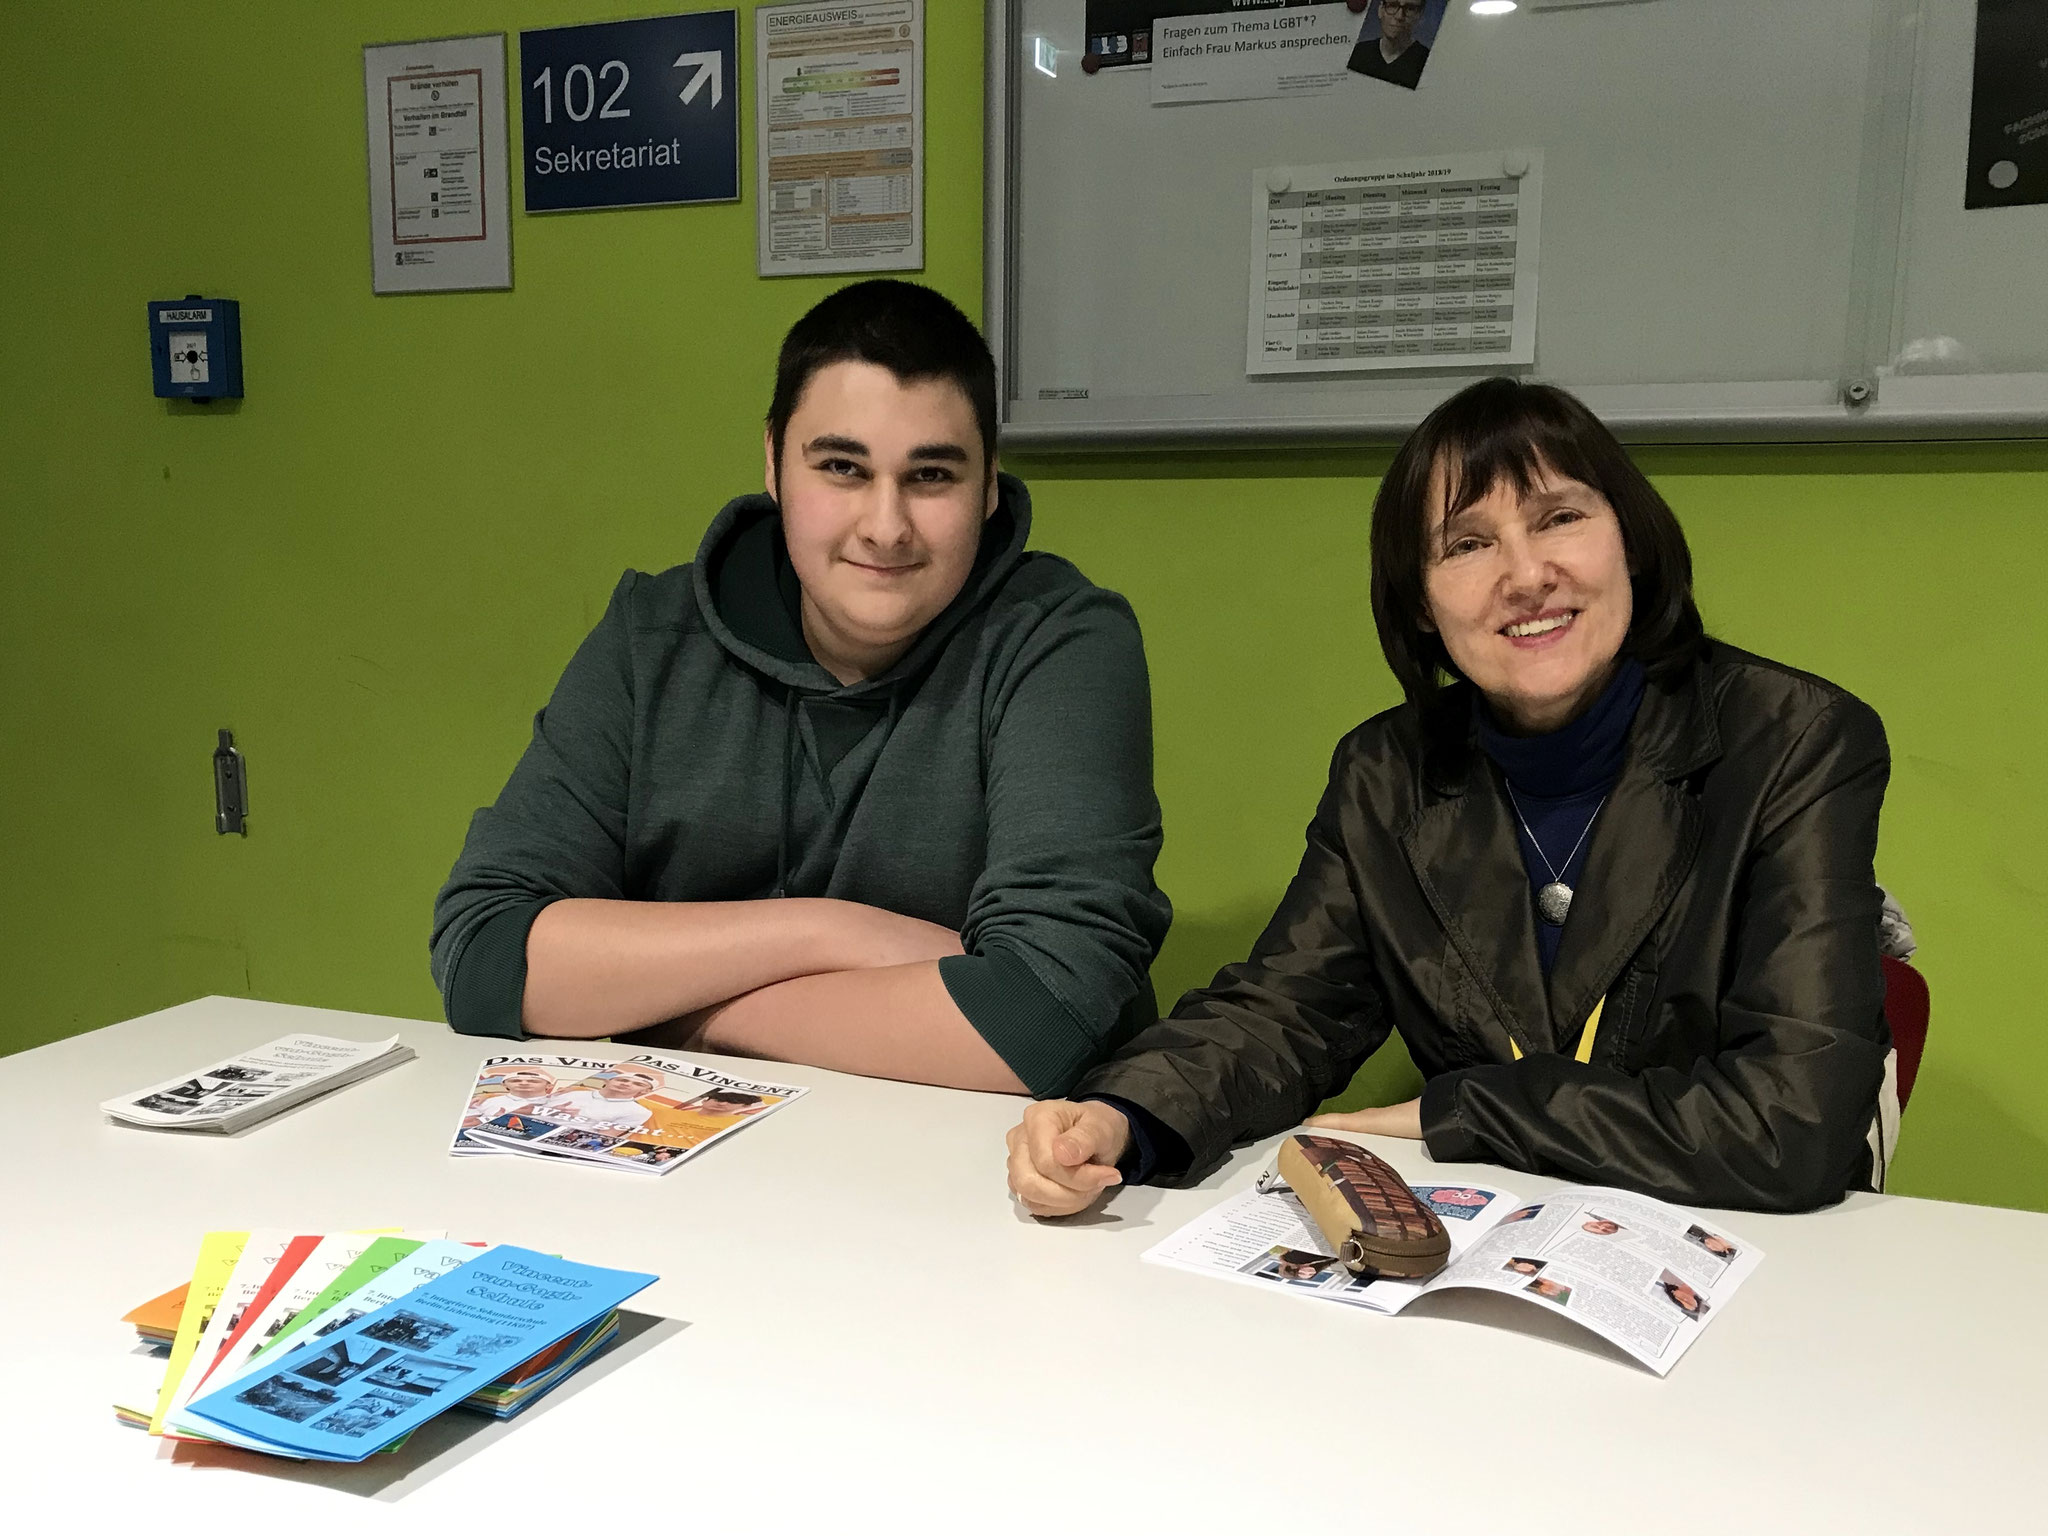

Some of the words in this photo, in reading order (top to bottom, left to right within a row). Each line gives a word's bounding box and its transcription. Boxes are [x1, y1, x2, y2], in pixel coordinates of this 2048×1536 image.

[769, 10, 858, 27] ENERGIEAUSWEIS
[1163, 27, 1201, 40] Fragen
[1204, 25, 1228, 35] zum
[1231, 22, 1270, 33] Thema
[1162, 44, 1203, 58] Einfach
[1206, 43, 1231, 55] Frau
[1234, 41, 1277, 52] Markus
[1279, 33, 1351, 50] ansprechen.
[533, 60, 630, 124] 102
[535, 138, 680, 175] Sekretariat
[1334, 174, 1385, 183] Ordnungsgruppe
[1396, 170, 1426, 179] Schuljahr
[166, 311, 207, 321] HAUSALARM
[486, 1056, 543, 1067] DAS
[629, 1054, 680, 1071] DAS
[692, 1066, 799, 1096] VINCENT
[532, 1105, 588, 1123] Was
[415, 1298, 494, 1324] Berlin-Lichtenberg
[430, 1294, 477, 1311] Integrierte
[477, 1306, 547, 1325] Sekundarschule
